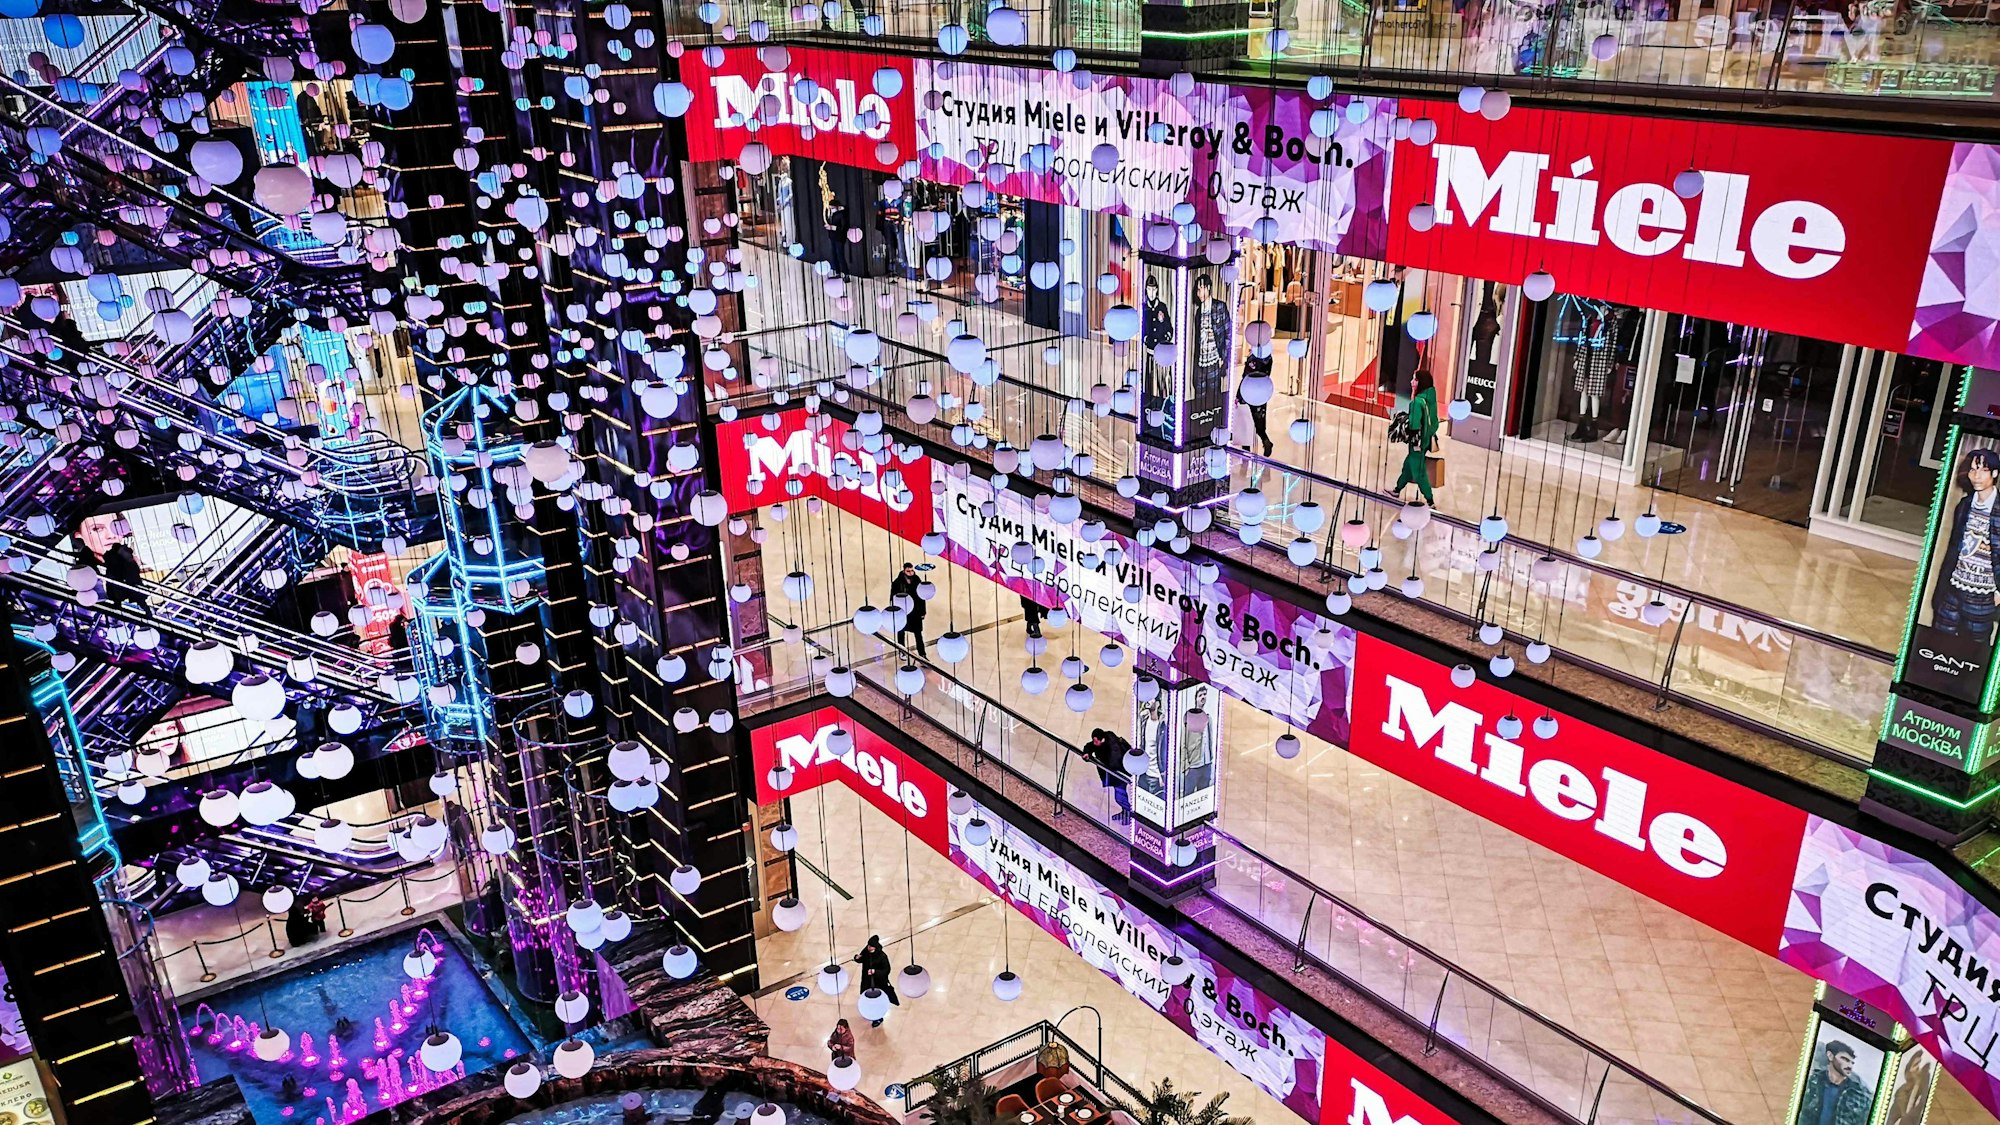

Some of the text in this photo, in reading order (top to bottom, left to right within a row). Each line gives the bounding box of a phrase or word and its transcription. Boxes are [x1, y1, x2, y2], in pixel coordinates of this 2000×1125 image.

[942, 90, 1016, 127] Студия
[1025, 99, 1086, 135] Miele
[1096, 116, 1107, 137] и
[1231, 121, 1254, 156] &
[1207, 171, 1223, 199] 0
[1230, 179, 1305, 214] этаж
[1431, 143, 1846, 279] Miele
[1190, 406, 1222, 421] GANT
[1140, 461, 1172, 480] МОСКВА
[956, 493, 1024, 542] Студия
[1032, 524, 1086, 568] Miele
[1116, 562, 1208, 625] Villeroy
[1215, 600, 1234, 633] &
[1242, 613, 1321, 671] Boch.
[1194, 634, 1207, 657] 0
[1213, 646, 1279, 692] этаж
[1919, 648, 1980, 672] GANT
[1933, 663, 1960, 676] gant.ru
[1892, 723, 1963, 760] МОСКВА
[1902, 709, 1962, 740] Атриум
[1381, 674, 1728, 879] Miele
[1135, 835, 1164, 858] МОСКВА
[996, 861, 1259, 1063] ТРЦ Европейский 0 этаж
[1038, 862, 1088, 912] Miele
[1095, 906, 1105, 925] и
[1202, 977, 1219, 1004] &
[1226, 1000, 1296, 1057] Boch.
[1922, 970, 1999, 1070] ТРЦ
